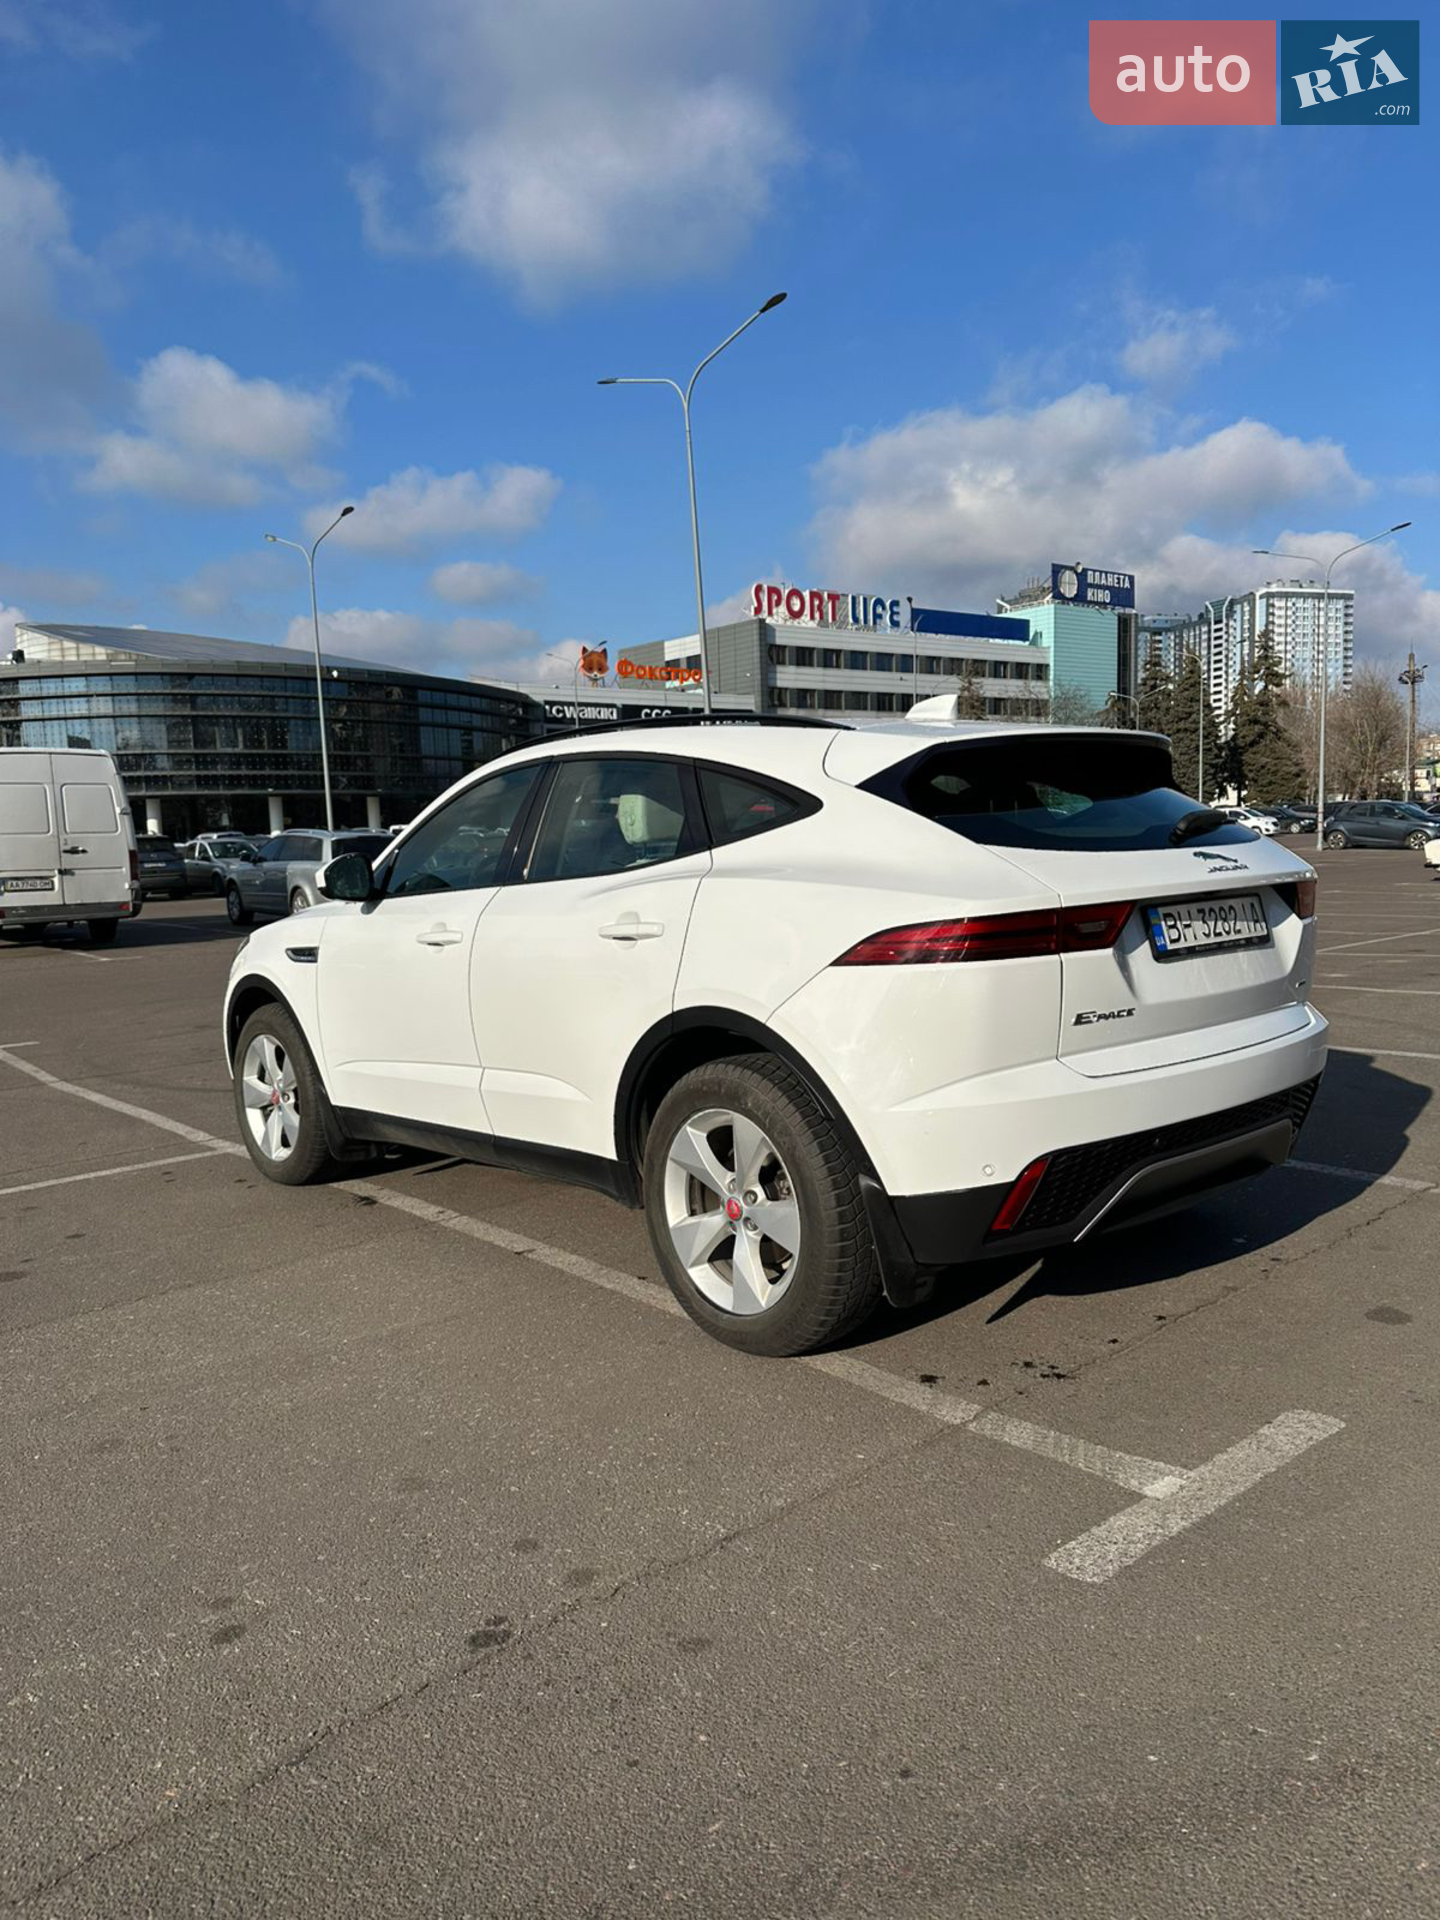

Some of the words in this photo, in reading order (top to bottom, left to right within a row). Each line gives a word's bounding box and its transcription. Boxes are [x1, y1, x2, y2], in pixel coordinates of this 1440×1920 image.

[1087, 570, 1131, 589] ПЛАНЕТА
[751, 583, 841, 623] SPORT
[849, 593, 901, 628] LIFE
[1087, 588, 1111, 603] КІНО
[616, 658, 704, 684] Фокстро
[1163, 909, 1198, 945] BH
[1197, 904, 1242, 938] 3282
[1241, 901, 1265, 934] IA
